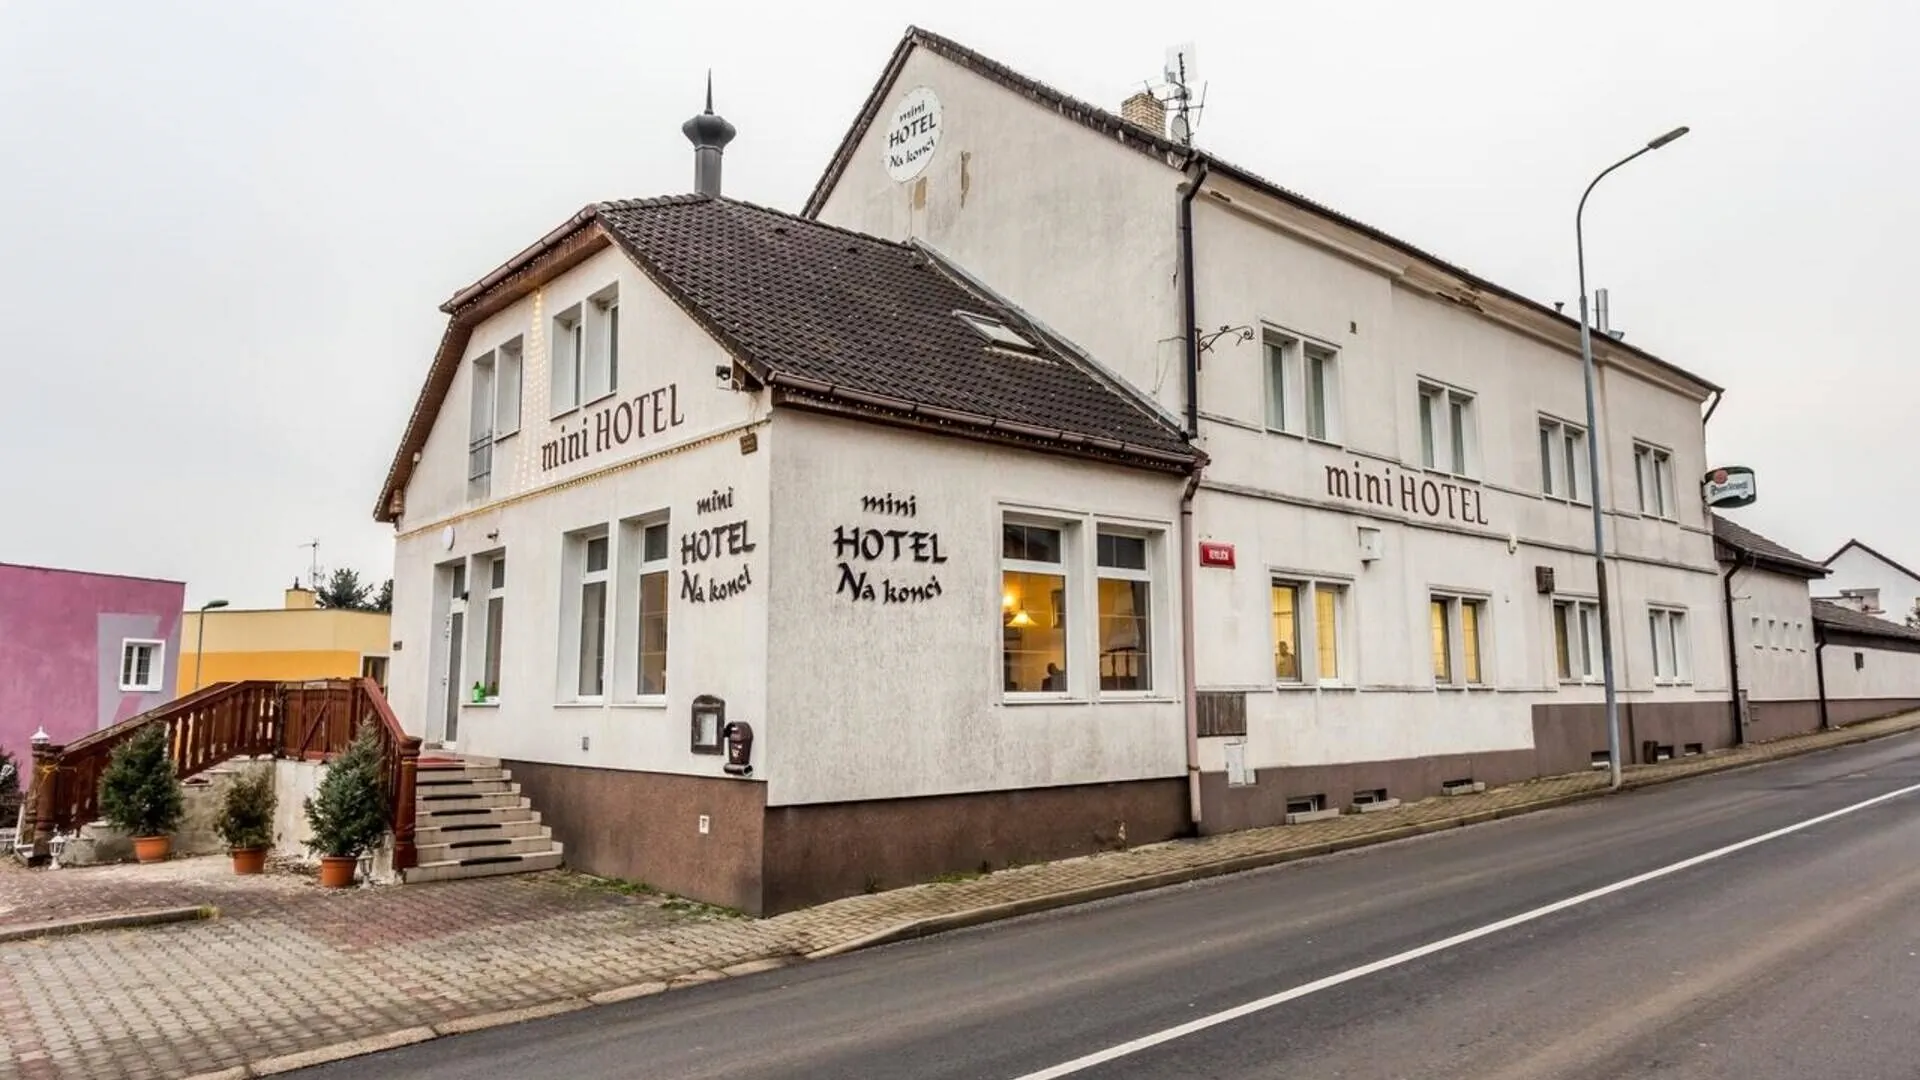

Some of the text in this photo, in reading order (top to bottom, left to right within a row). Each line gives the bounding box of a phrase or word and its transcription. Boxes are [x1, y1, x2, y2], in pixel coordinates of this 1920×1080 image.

[899, 100, 925, 122] mini
[889, 112, 937, 149] HOTEL
[889, 155, 904, 168] Na
[541, 383, 685, 472] mini HOTEL
[696, 486, 734, 515] mini
[861, 492, 917, 518] mini
[1325, 460, 1489, 525] mini HOTEL
[680, 520, 756, 565] HOTEL
[832, 524, 948, 564] HOTEL
[680, 569, 705, 604] Na
[836, 561, 942, 605] Na konci
